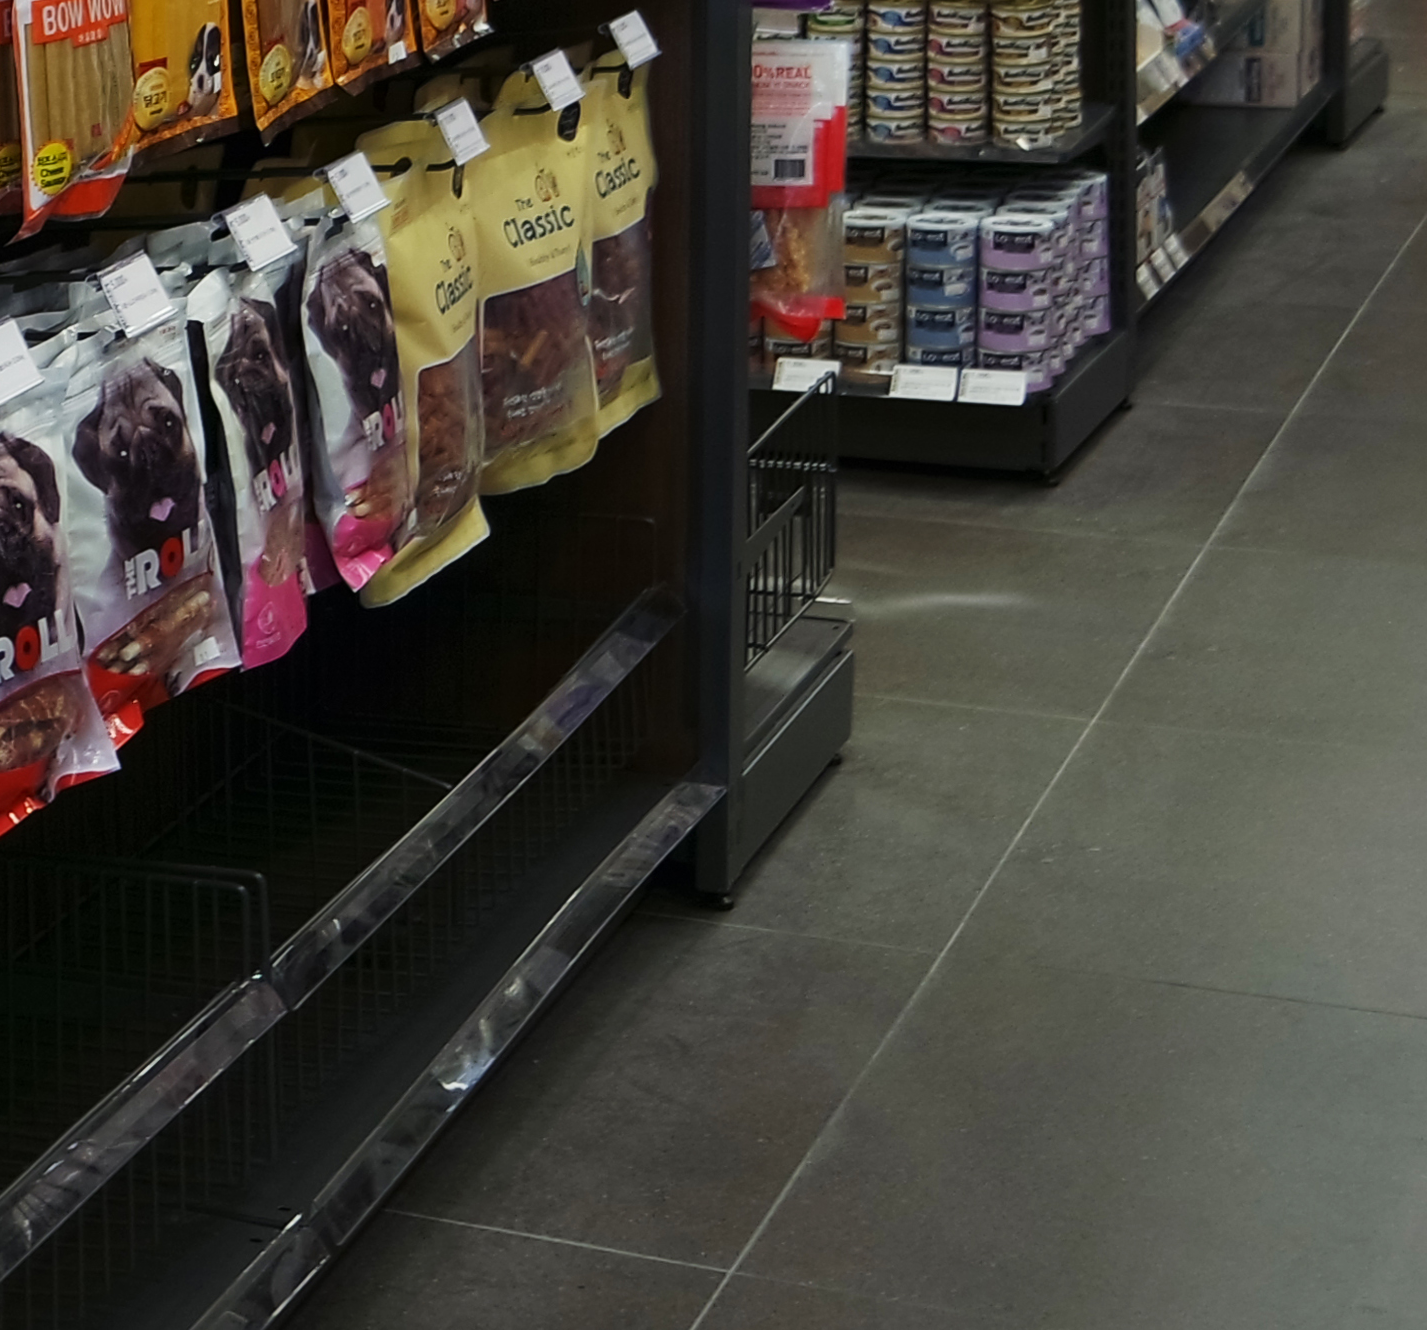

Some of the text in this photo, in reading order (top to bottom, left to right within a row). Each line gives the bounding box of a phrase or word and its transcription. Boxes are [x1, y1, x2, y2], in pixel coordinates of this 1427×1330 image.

[776, 64, 812, 79] REAL
[594, 156, 641, 199] Classic
[503, 204, 576, 249] Classic
[515, 197, 533, 212] The
[435, 264, 473, 316] Classic
[370, 396, 406, 452] ROLL
[124, 518, 209, 601] THE ROLL
